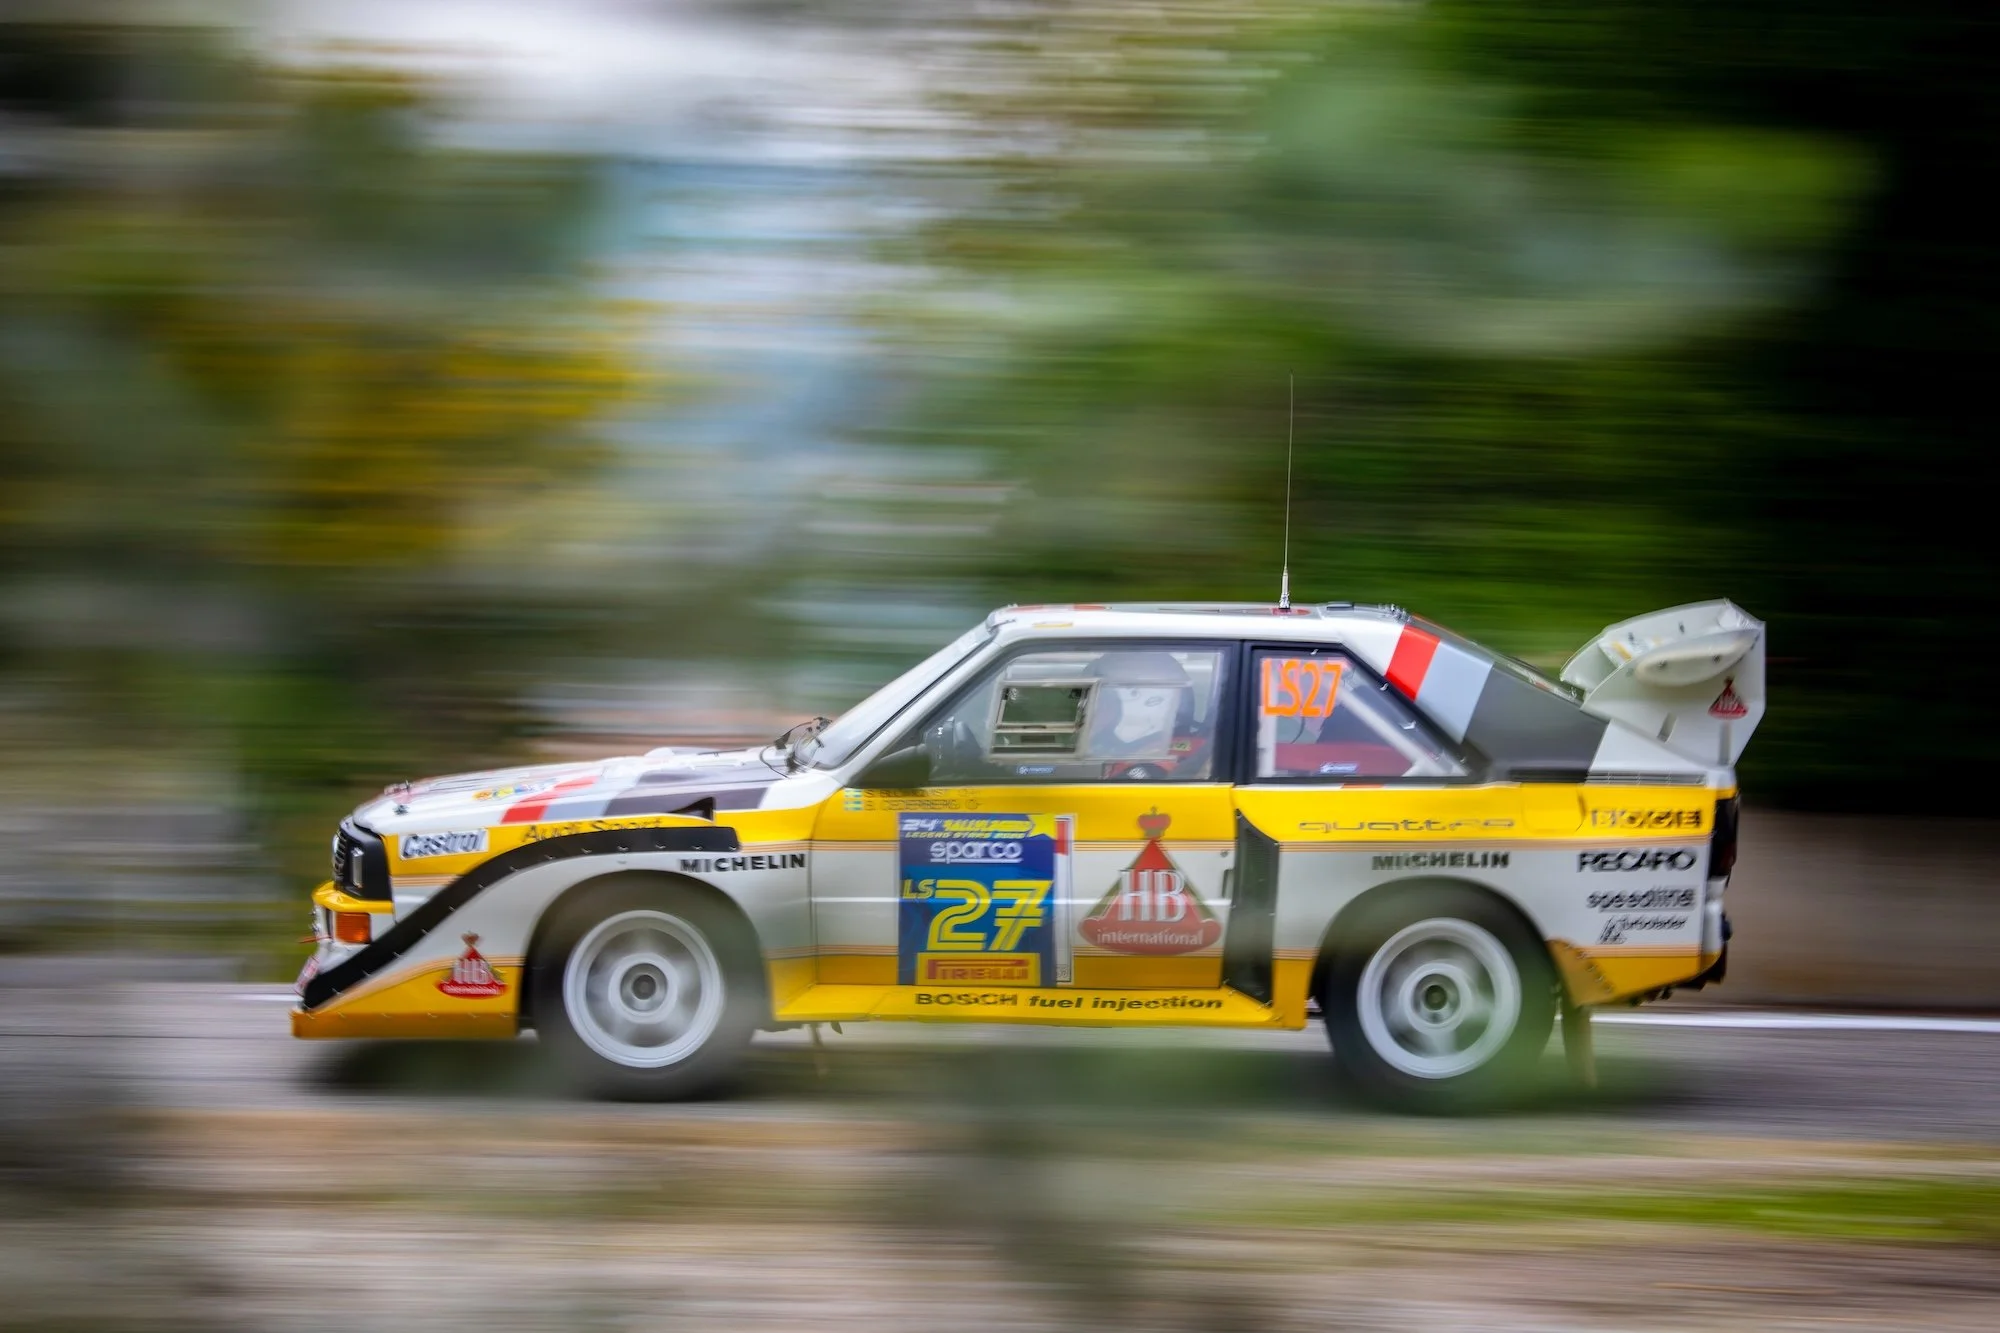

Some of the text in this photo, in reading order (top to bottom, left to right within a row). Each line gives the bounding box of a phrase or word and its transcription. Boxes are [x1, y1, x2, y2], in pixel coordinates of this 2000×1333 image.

[1262, 657, 1342, 717] LS27
[1299, 819, 1514, 833] quattro
[403, 832, 484, 858] Castrol
[930, 841, 1022, 864] sparco
[680, 853, 805, 873] MICHELIN
[1371, 852, 1510, 870] MICHELIN
[1577, 849, 1697, 872] RECARO
[1120, 869, 1186, 922] HB
[903, 879, 1053, 950] LS 27
[1097, 928, 1204, 945] international
[927, 959, 1029, 980] PIRELLI
[915, 993, 1223, 1011] BOSCH fuel injection
